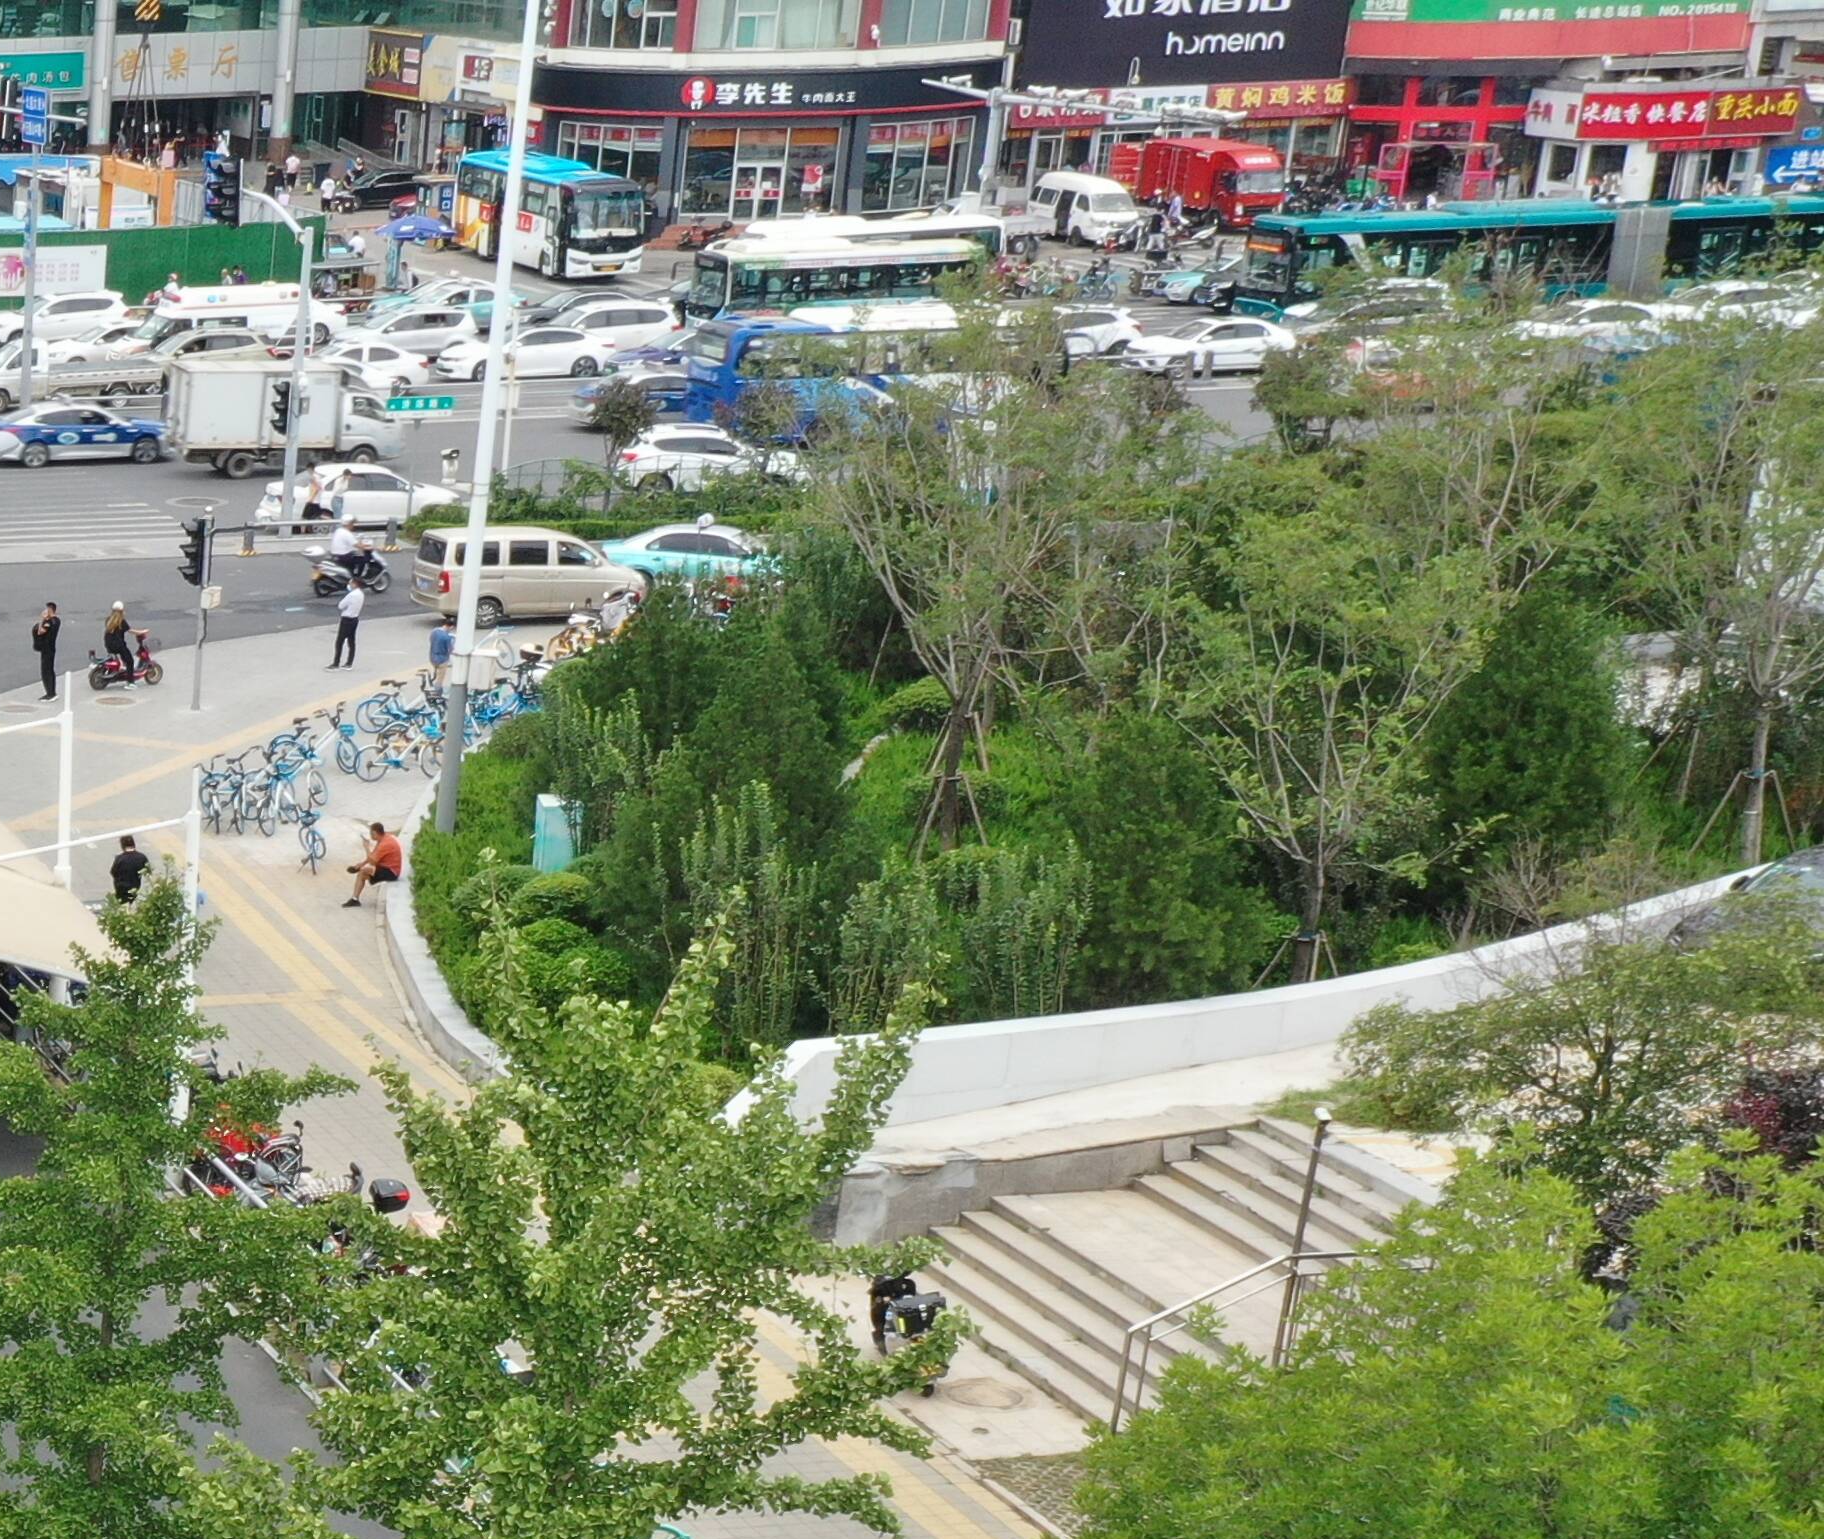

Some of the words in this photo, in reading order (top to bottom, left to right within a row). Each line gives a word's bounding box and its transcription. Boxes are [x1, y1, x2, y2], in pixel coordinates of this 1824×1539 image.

[714, 82, 794, 105] 李先生
[1214, 82, 1346, 109] 黄焖鸡米饭
[1715, 91, 1799, 121] 重庆小面
